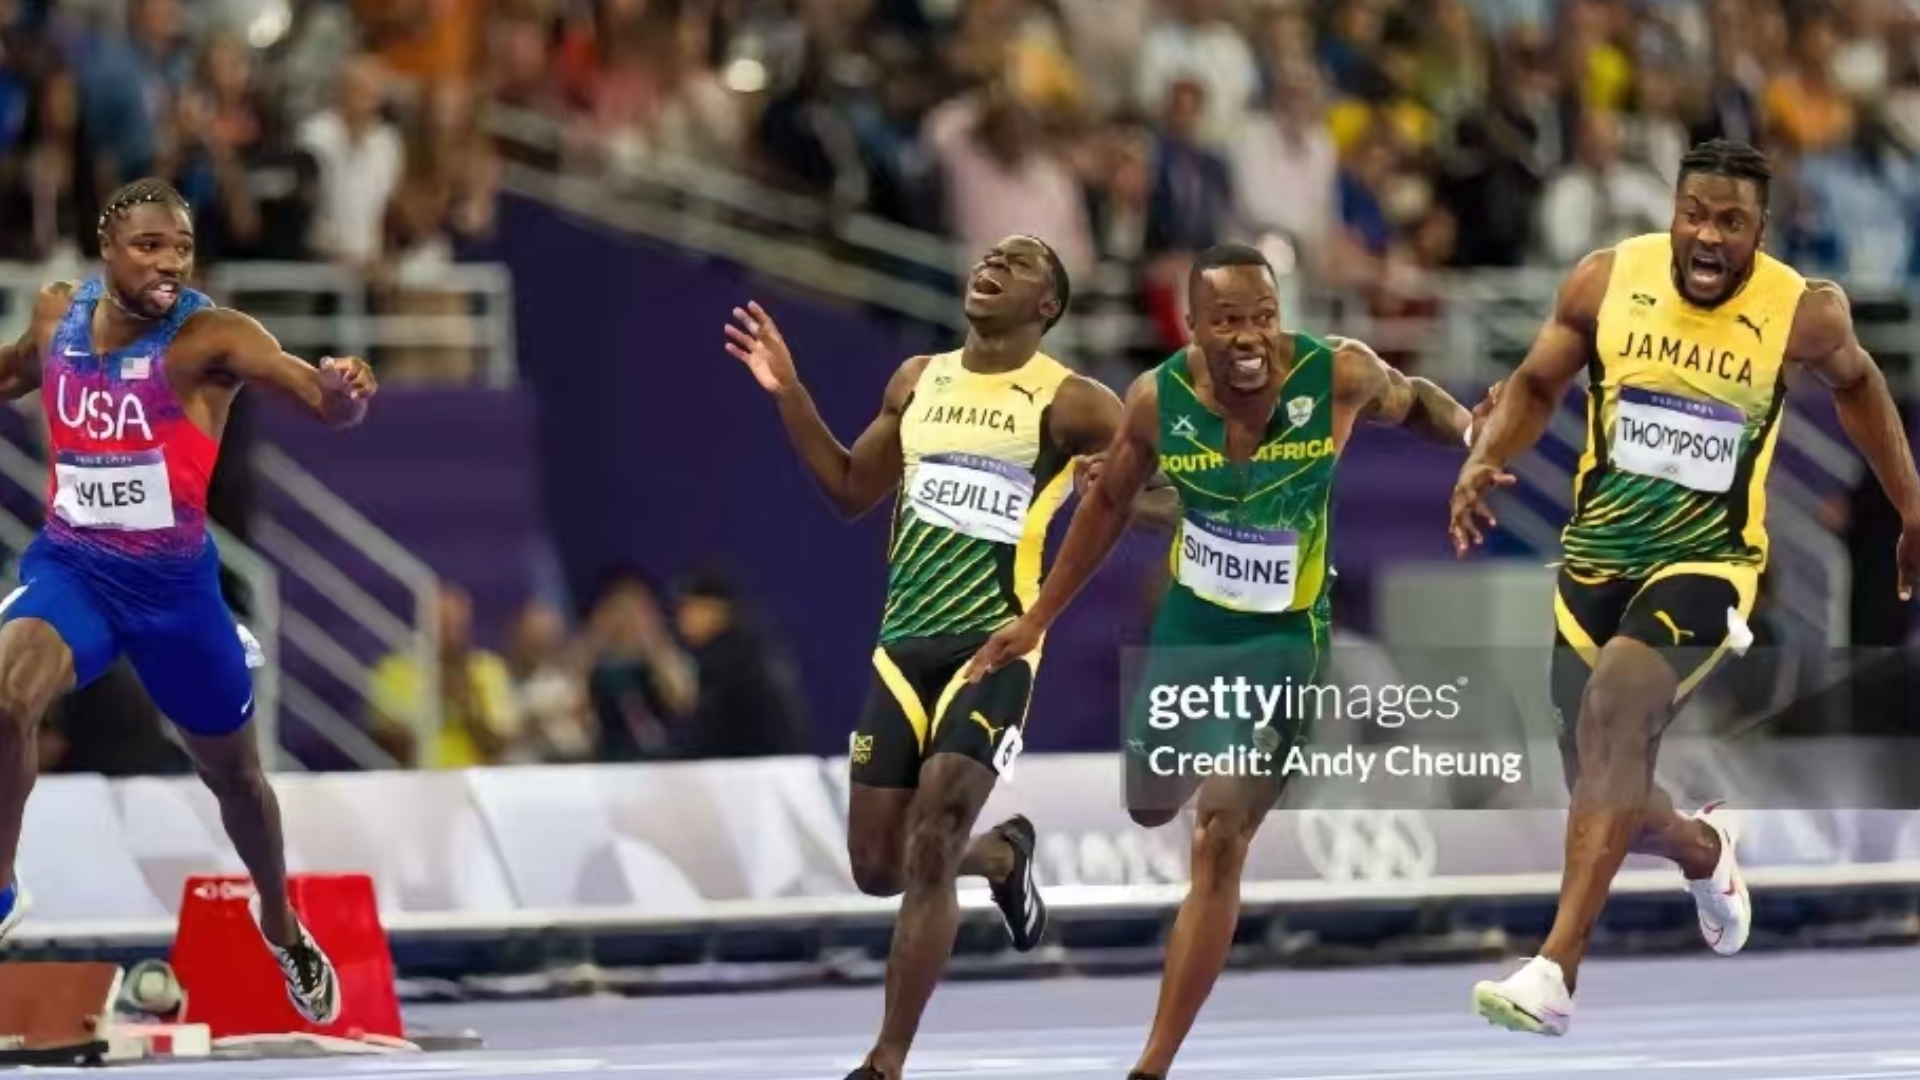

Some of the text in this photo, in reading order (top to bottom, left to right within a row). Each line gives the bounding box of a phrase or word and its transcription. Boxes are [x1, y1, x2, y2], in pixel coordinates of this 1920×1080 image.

[1619, 332, 1752, 387] JAMAICA
[57, 374, 153, 440] USA
[919, 406, 1016, 434] JAMAICA
[1159, 437, 1335, 473] SOUTH AFRICA
[1621, 416, 1735, 463] THOMPSON
[919, 478, 1023, 521] SEVILLE
[1184, 534, 1291, 585] SIMBINE
